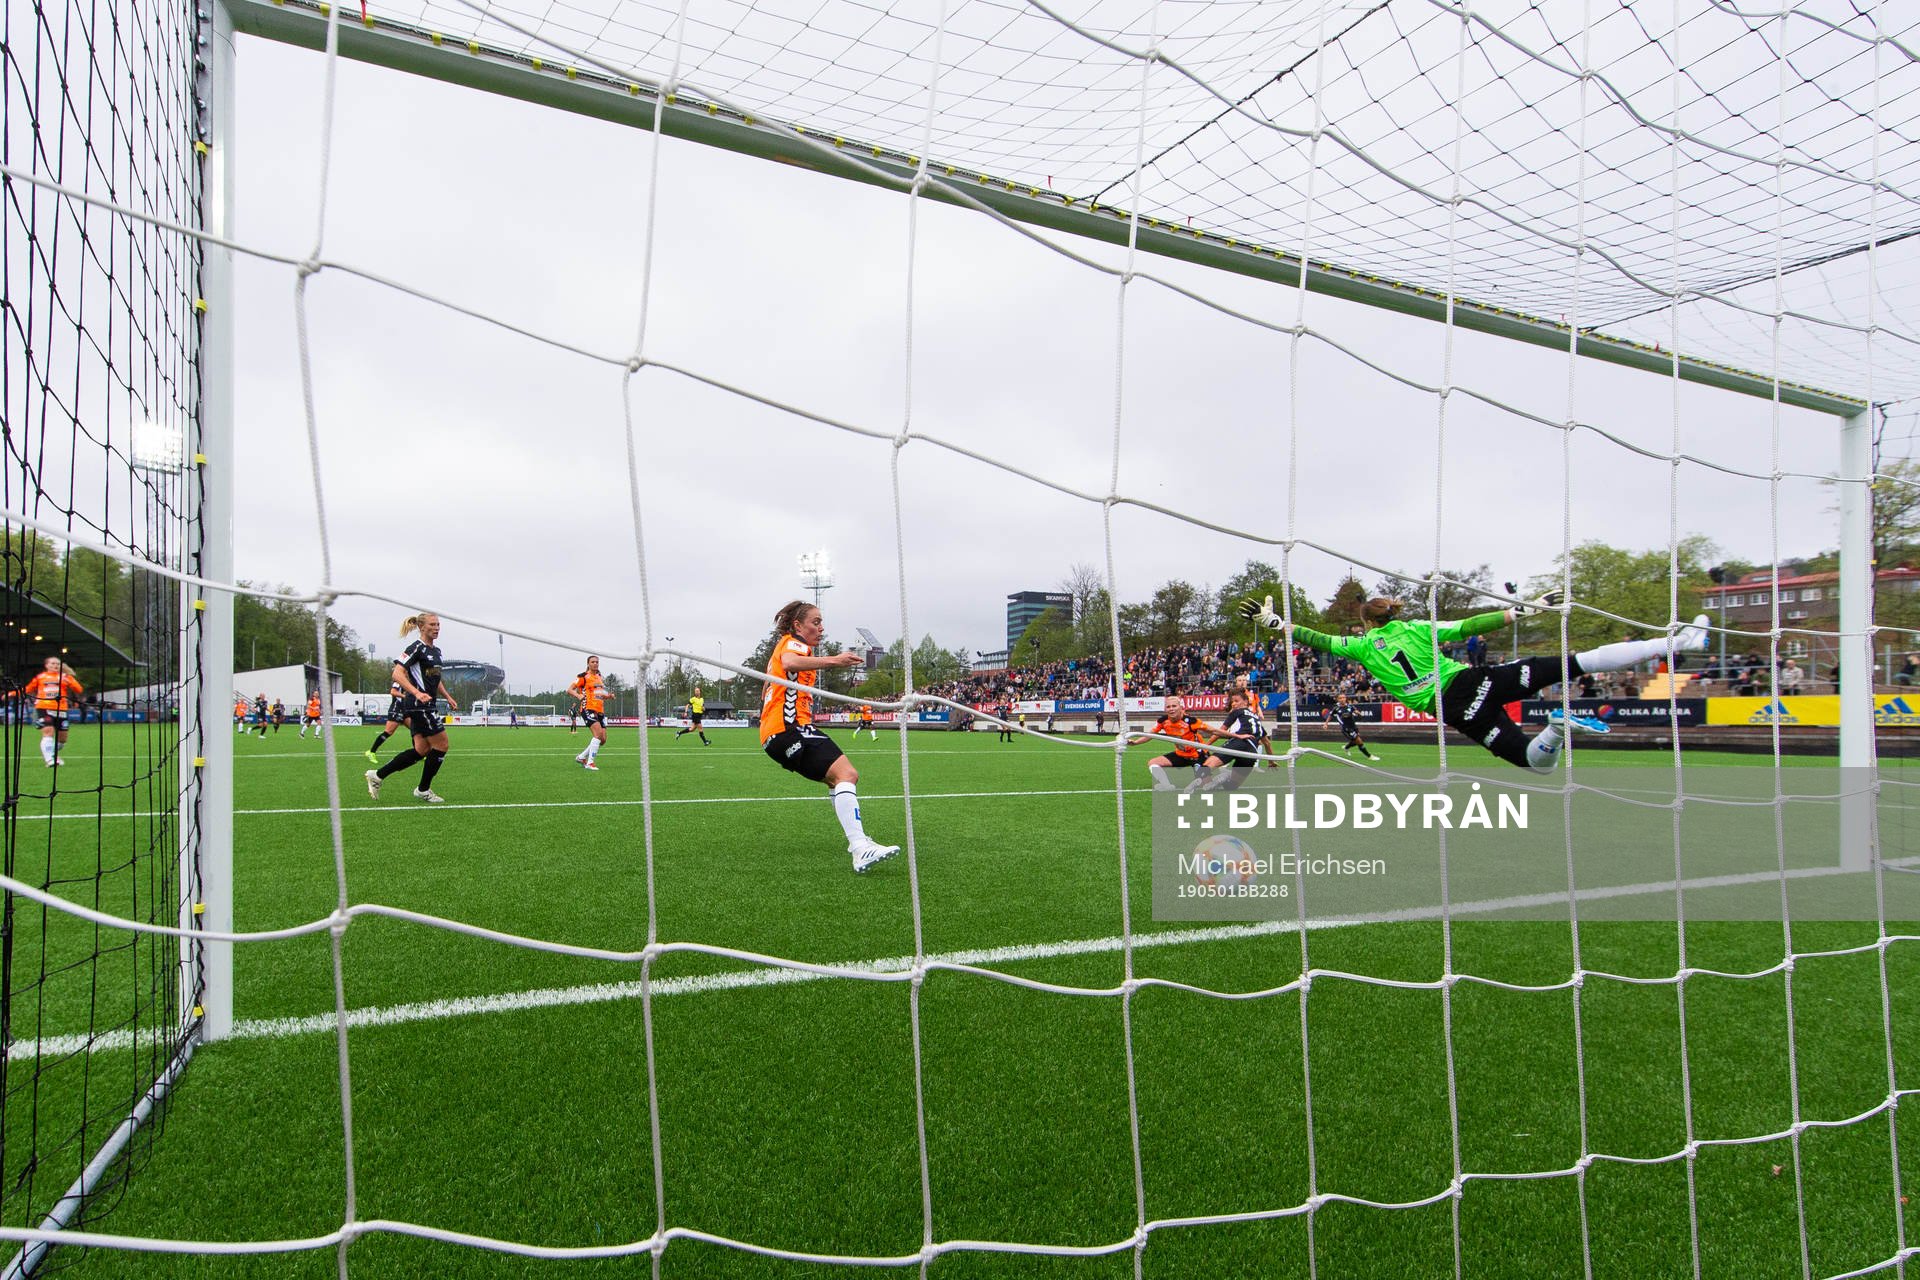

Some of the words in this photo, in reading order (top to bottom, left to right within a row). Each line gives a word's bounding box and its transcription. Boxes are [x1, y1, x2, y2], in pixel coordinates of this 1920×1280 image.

[1391, 649, 1418, 682] 1
[1180, 697, 1228, 709] AUHAUS
[1463, 675, 1493, 721] skandia
